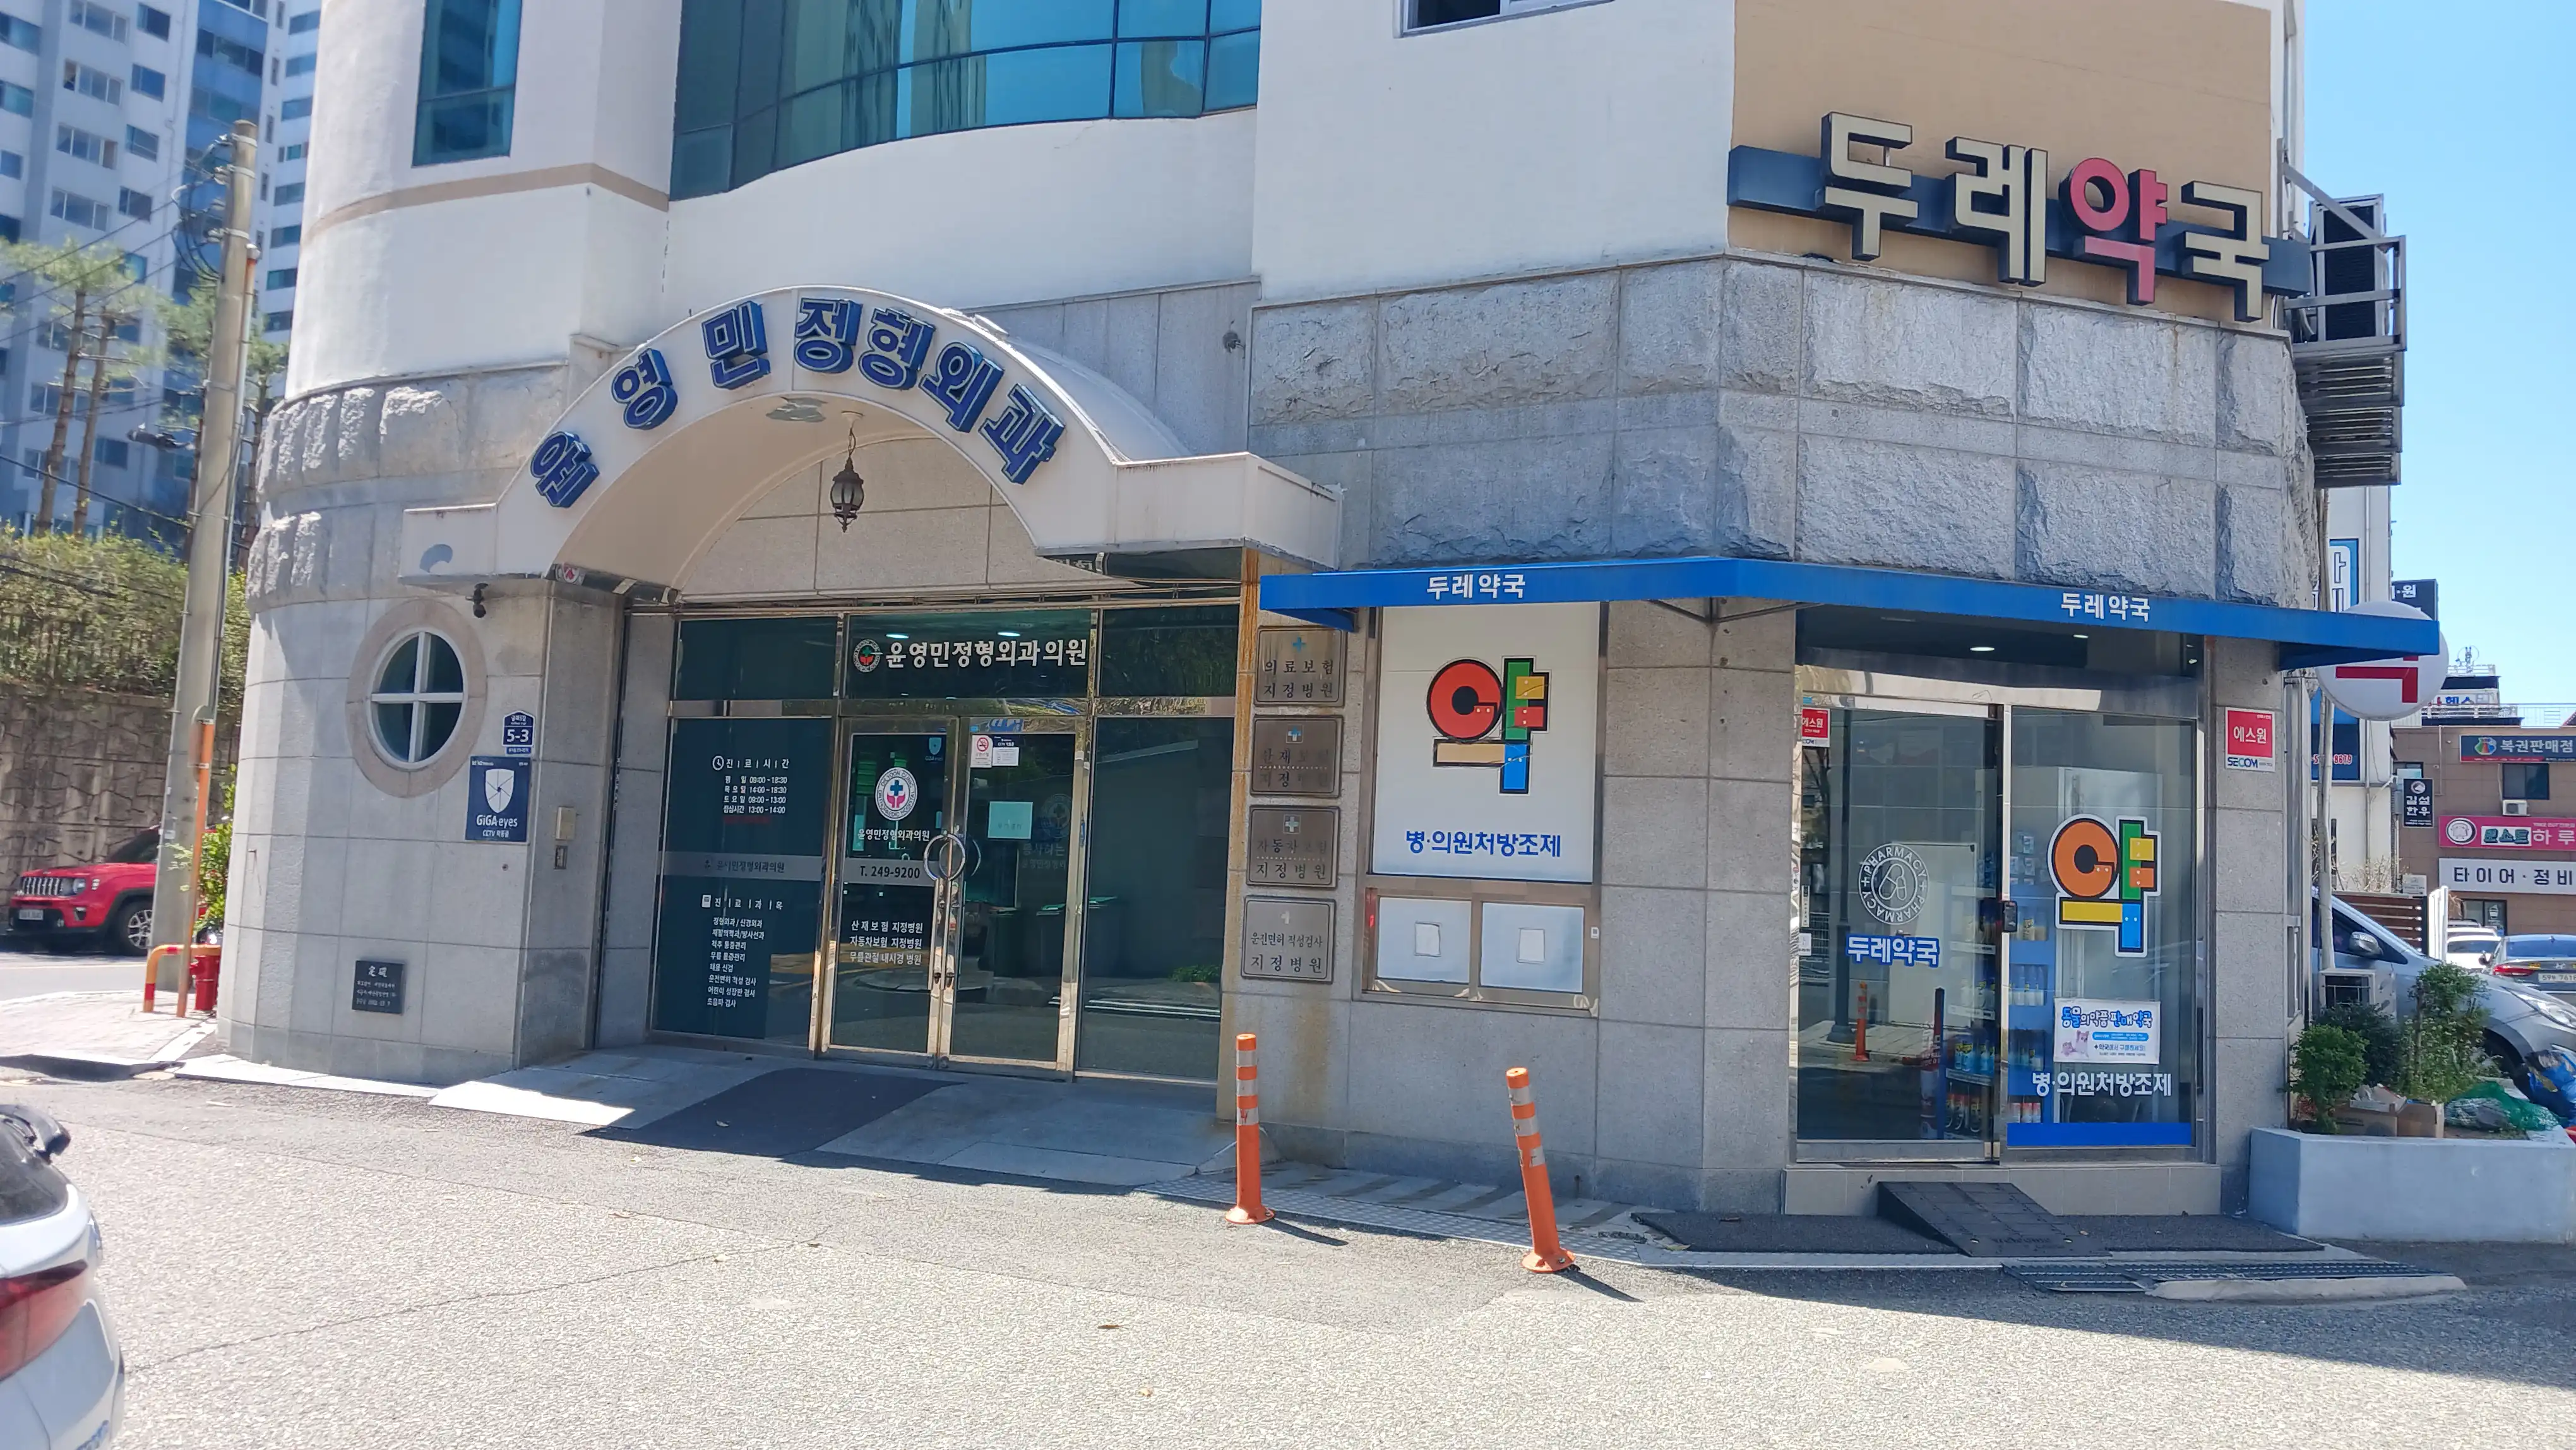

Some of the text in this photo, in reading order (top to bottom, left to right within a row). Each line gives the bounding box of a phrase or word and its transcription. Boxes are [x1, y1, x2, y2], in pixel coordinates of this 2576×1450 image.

[1820, 112, 2270, 323] 두레약국
[1426, 573, 1526, 599] 두레약국
[2060, 592, 2151, 623] 두레약국
[885, 639, 1087, 668] 윤영민정형외과의원
[506, 729, 529, 743] 5-3
[2233, 726, 2267, 744] 에스원
[2500, 740, 2573, 753] 복권판매점
[2227, 757, 2258, 768] SECOM
[1863, 846, 1928, 877] PHARMACY
[871, 866, 921, 879] 249-9200
[891, 921, 923, 933] 지정병원
[850, 935, 922, 949] 자동차보험 지정병원
[1847, 936, 1938, 966] 두레약국
[906, 954, 922, 966] 병원
[1250, 954, 1321, 973] 지정병원
[744, 977, 756, 986] 검사
[744, 988, 756, 998] 검사
[725, 999, 736, 1008] 검사
[2061, 1006, 2154, 1028] 동물의약품 판매약국
